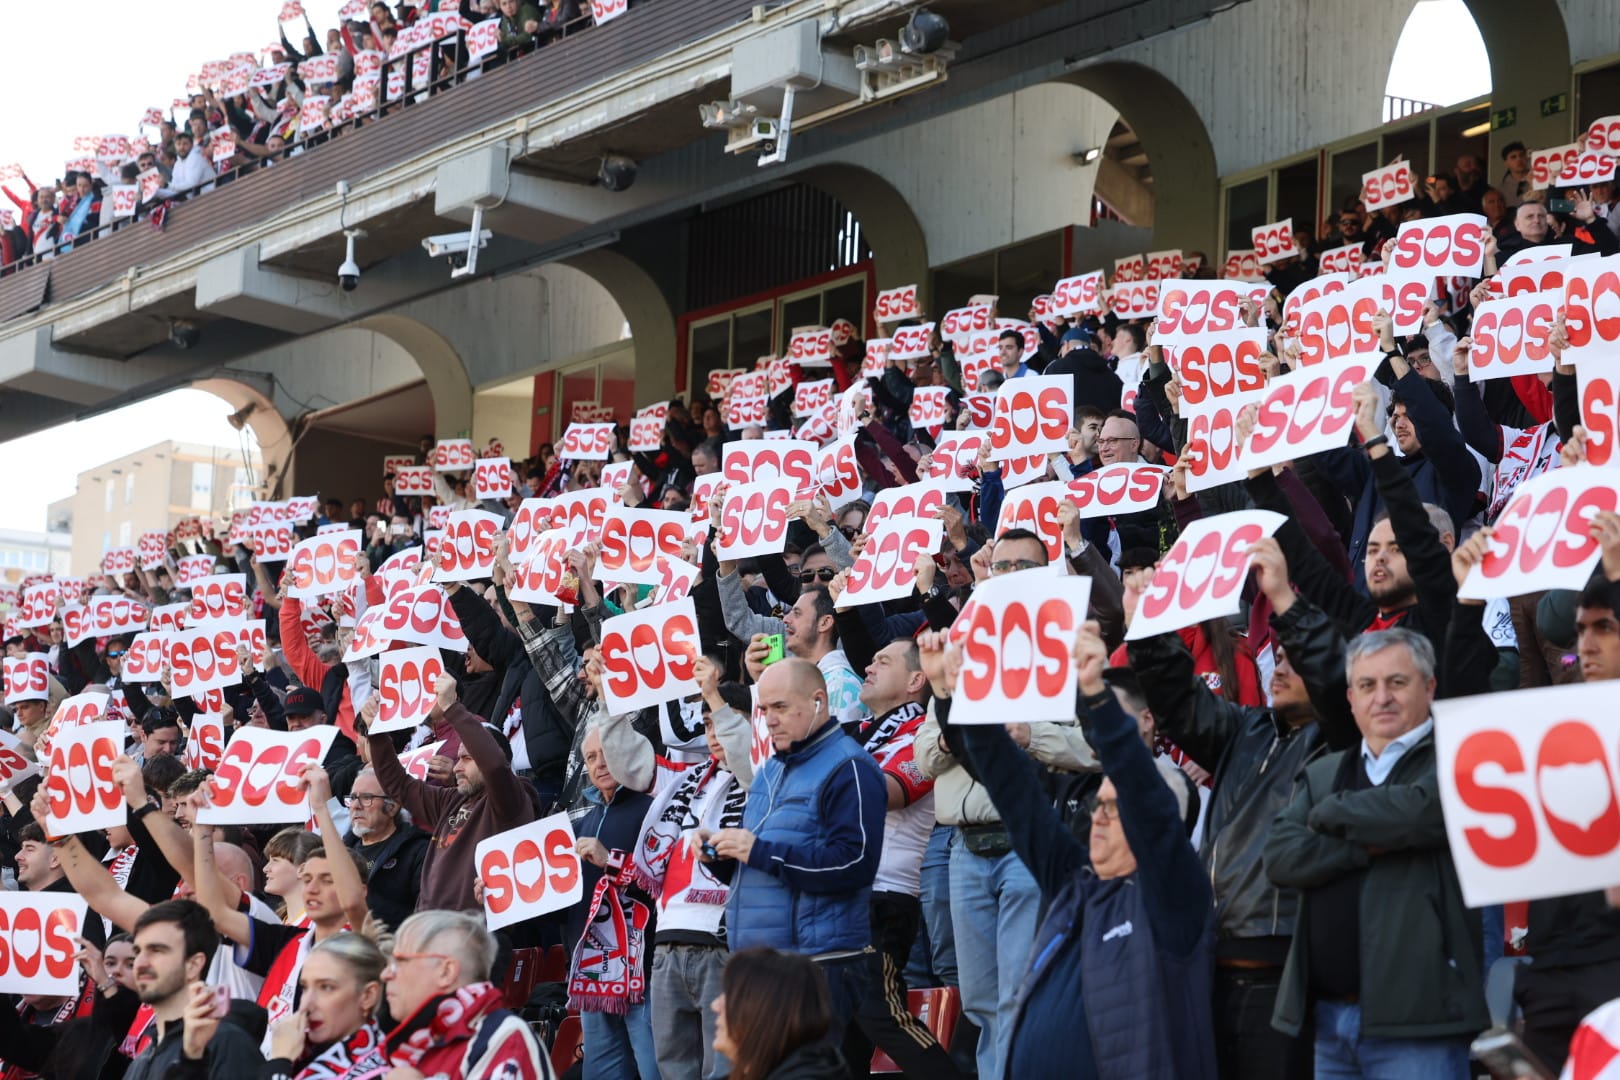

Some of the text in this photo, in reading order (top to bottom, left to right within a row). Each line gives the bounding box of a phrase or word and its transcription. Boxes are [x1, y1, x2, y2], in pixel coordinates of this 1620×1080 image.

[1365, 168, 1409, 204] SOS
[1254, 226, 1292, 257] SOS
[1395, 223, 1483, 268] SOS
[879, 290, 916, 317] SOS
[1055, 276, 1098, 308] SOS
[1115, 286, 1158, 313] SOS
[1158, 289, 1238, 334] SOS
[942, 308, 988, 334] SOS
[1300, 297, 1380, 367] SOS
[1471, 304, 1553, 368] SOS
[790, 334, 829, 359] SOS
[893, 328, 930, 354] SOS
[1180, 340, 1265, 404] SOS
[730, 399, 766, 424] SOS
[796, 384, 830, 411] SOS
[909, 392, 945, 421] SOS
[1250, 365, 1367, 454] SOS
[630, 423, 662, 446] SOS
[991, 387, 1070, 449] SOS
[436, 444, 472, 466] SOS
[565, 428, 610, 453] SOS
[398, 471, 433, 490] SOS
[476, 464, 512, 492] SOS
[1065, 467, 1163, 509] SOS
[720, 488, 791, 548] SOS
[1481, 486, 1619, 578] SOS
[104, 549, 134, 570] SOS
[255, 528, 290, 557] SOS
[441, 519, 498, 572] SOS
[602, 517, 686, 573] SOS
[847, 529, 930, 594] SOS
[178, 559, 212, 583] SOS
[293, 539, 360, 589] SOS
[1143, 524, 1263, 619] SOS
[23, 589, 57, 620] SOS
[96, 601, 147, 629] SOS
[191, 583, 244, 620] SOS
[171, 632, 238, 688] SOS
[601, 614, 695, 698] SOS
[963, 599, 1074, 702] SOS
[380, 658, 442, 721] SOS
[48, 738, 122, 819] SOS
[208, 738, 321, 807] SOS
[1454, 720, 1620, 869] SO
[481, 829, 578, 913] SOS
[572, 980, 625, 995] RAYO
